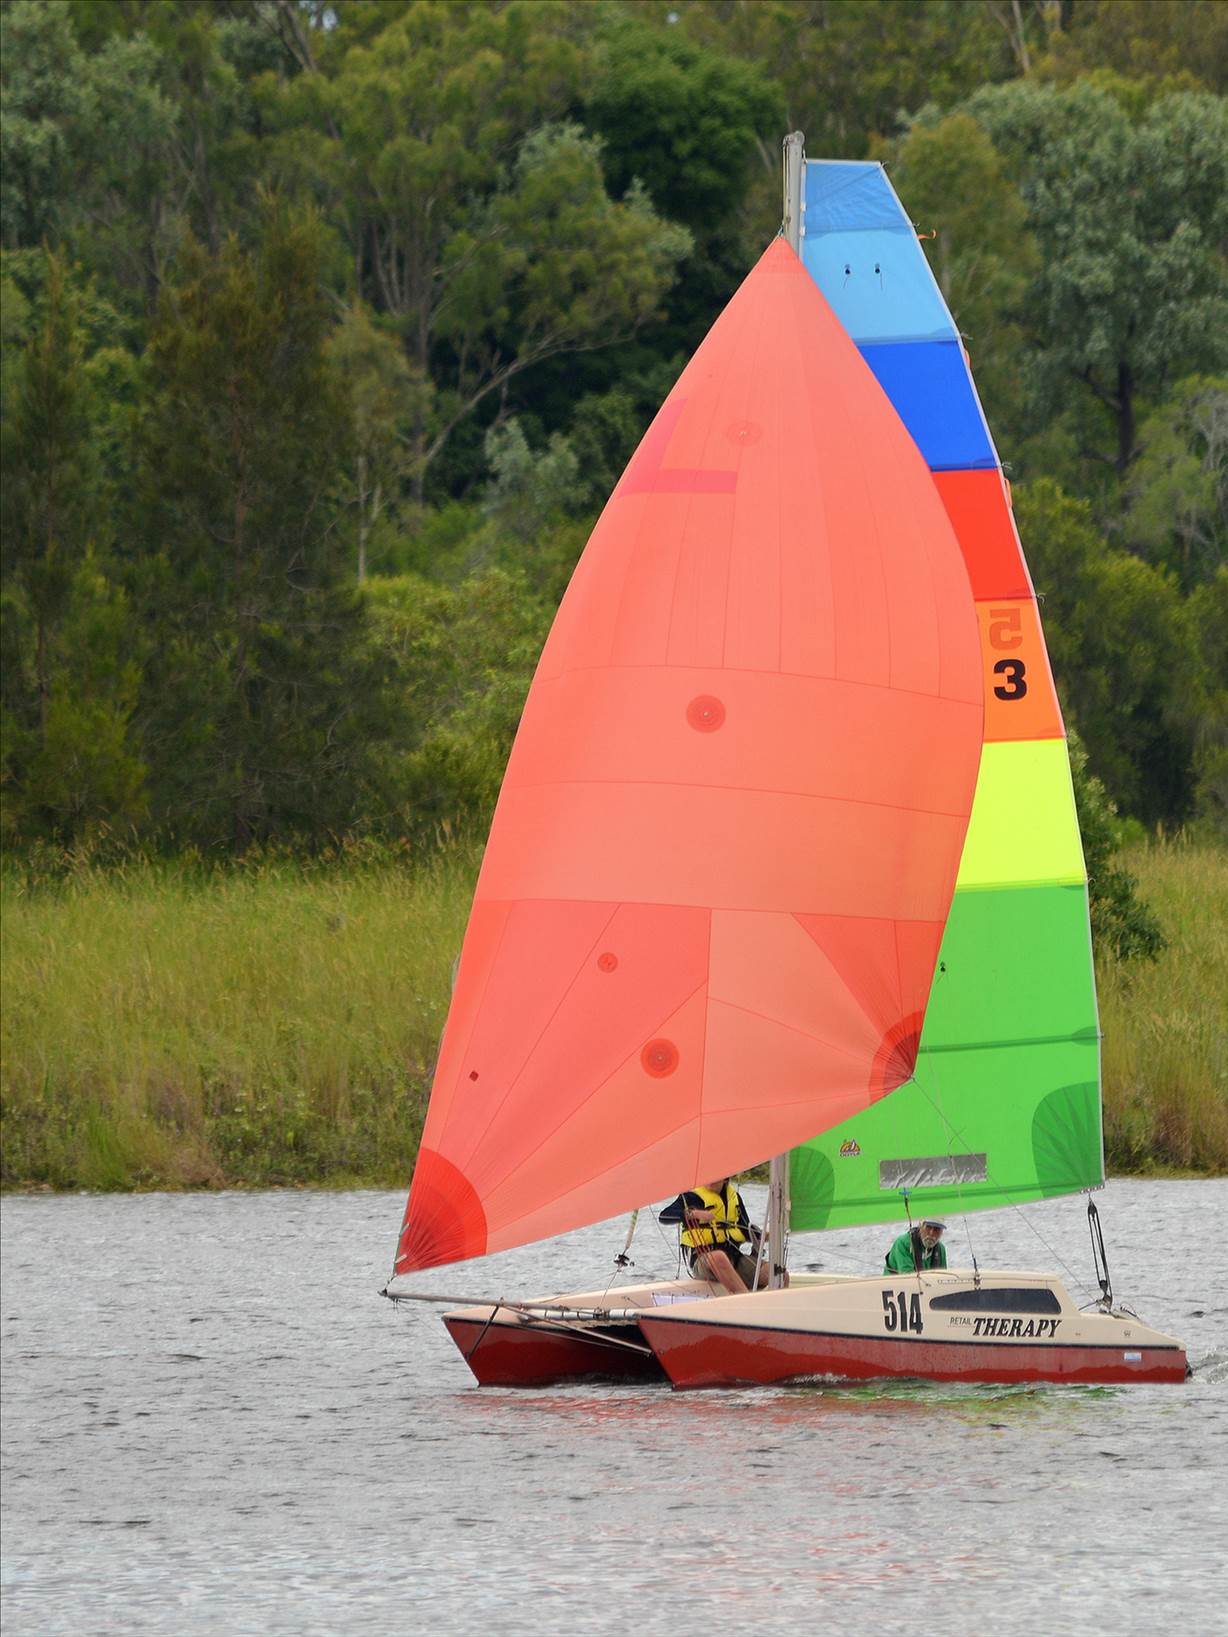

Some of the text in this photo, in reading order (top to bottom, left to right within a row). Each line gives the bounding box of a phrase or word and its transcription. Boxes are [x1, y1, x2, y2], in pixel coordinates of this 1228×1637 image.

[993, 658, 1027, 701] 3
[882, 1290, 924, 1335] 514
[950, 1316, 1062, 1338] RETAIL THERAPY
